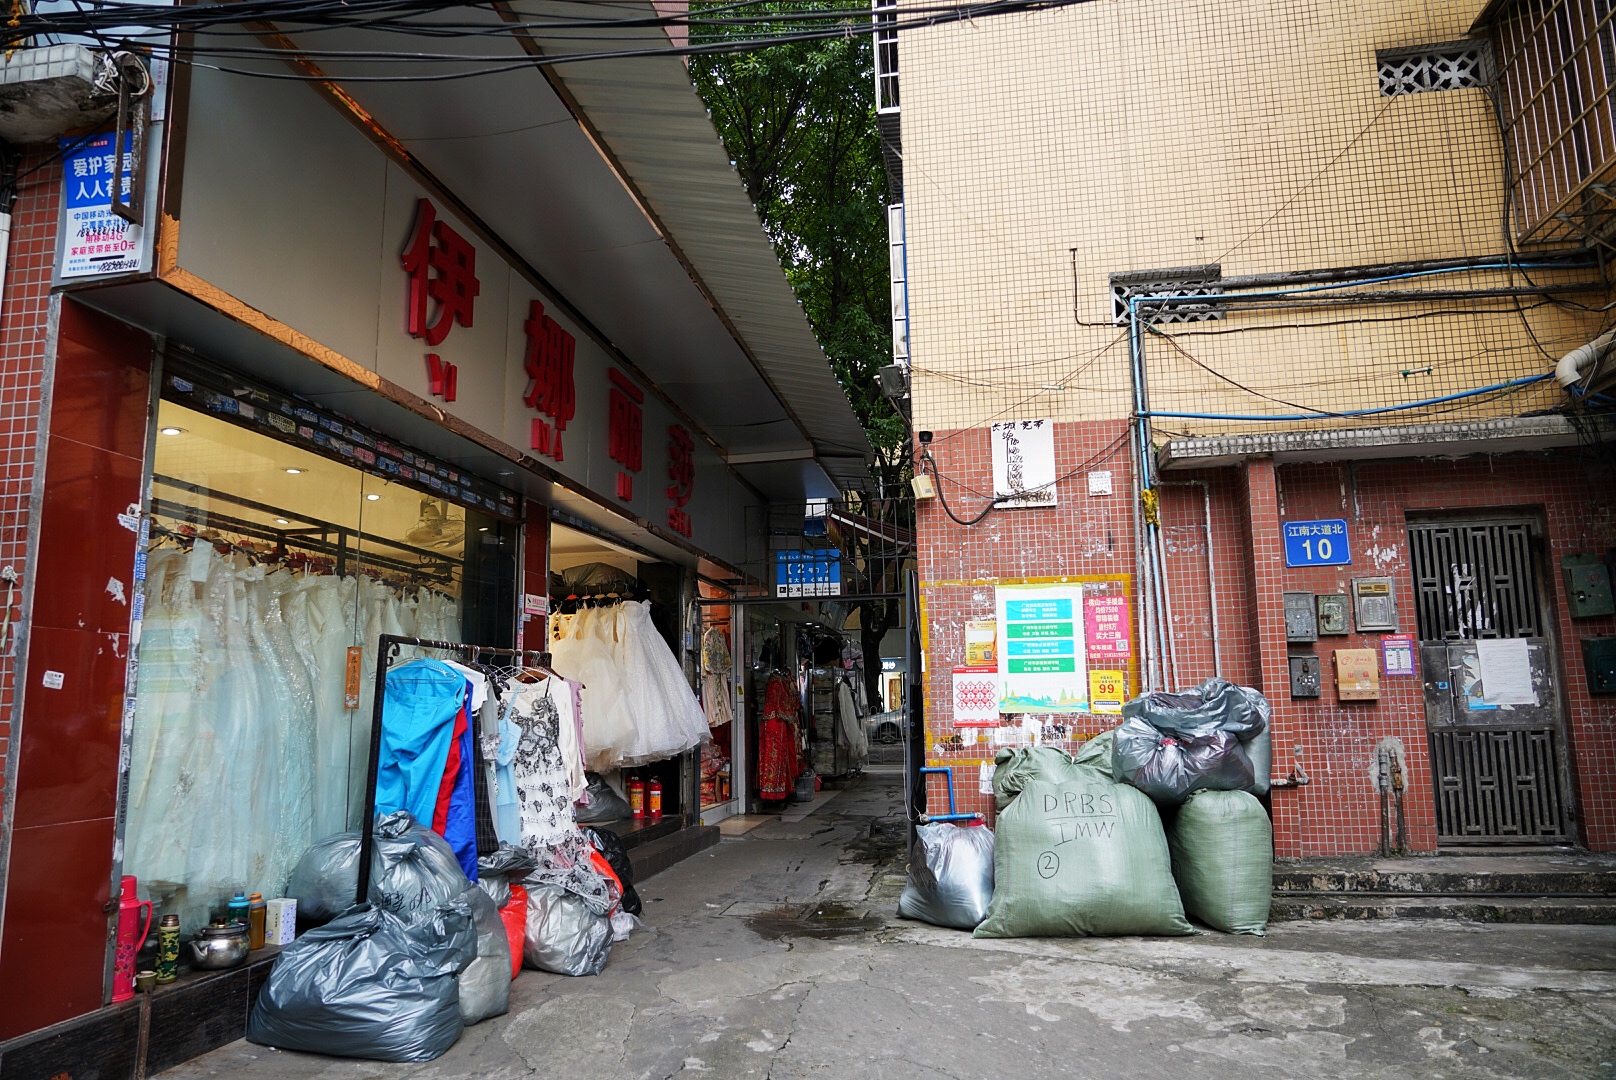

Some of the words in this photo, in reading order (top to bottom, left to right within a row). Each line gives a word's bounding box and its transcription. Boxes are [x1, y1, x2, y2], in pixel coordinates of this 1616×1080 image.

[70, 240, 136, 256] 家庭宽带低至0元
[425, 353, 458, 402] YI
[531, 417, 564, 462] NA
[1288, 524, 1344, 537] 江南大道北
[1302, 538, 1333, 560] 10
[1099, 683, 1115, 694] 99
[1051, 821, 1116, 848] IMW
